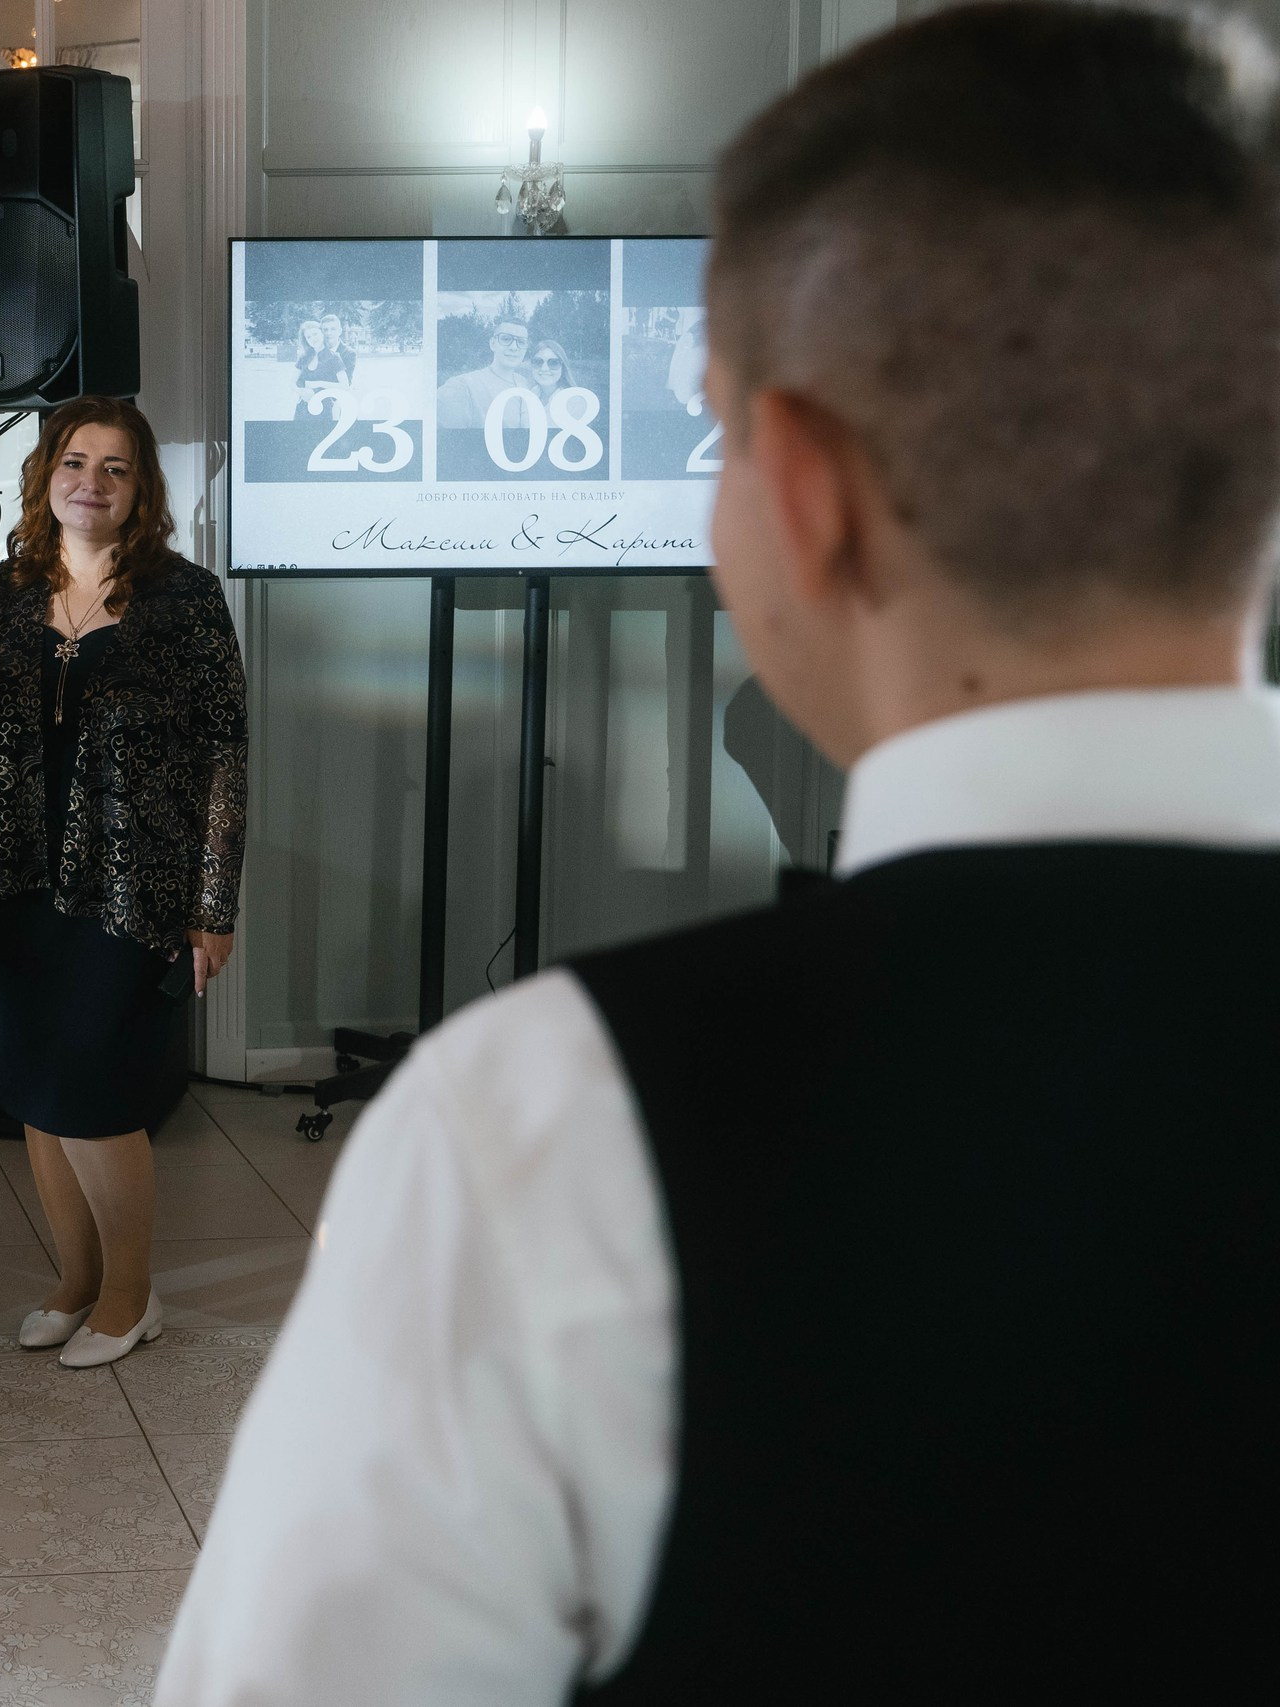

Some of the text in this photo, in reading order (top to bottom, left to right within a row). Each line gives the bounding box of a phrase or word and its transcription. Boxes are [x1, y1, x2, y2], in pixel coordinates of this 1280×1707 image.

[306, 387, 415, 473] 23
[484, 386, 604, 473] 08
[416, 491, 626, 503] ДОБРО ПОЖАЛОВАТЬ НА СВАДЬБУ
[331, 516, 499, 552] Максим
[511, 513, 546, 550] &
